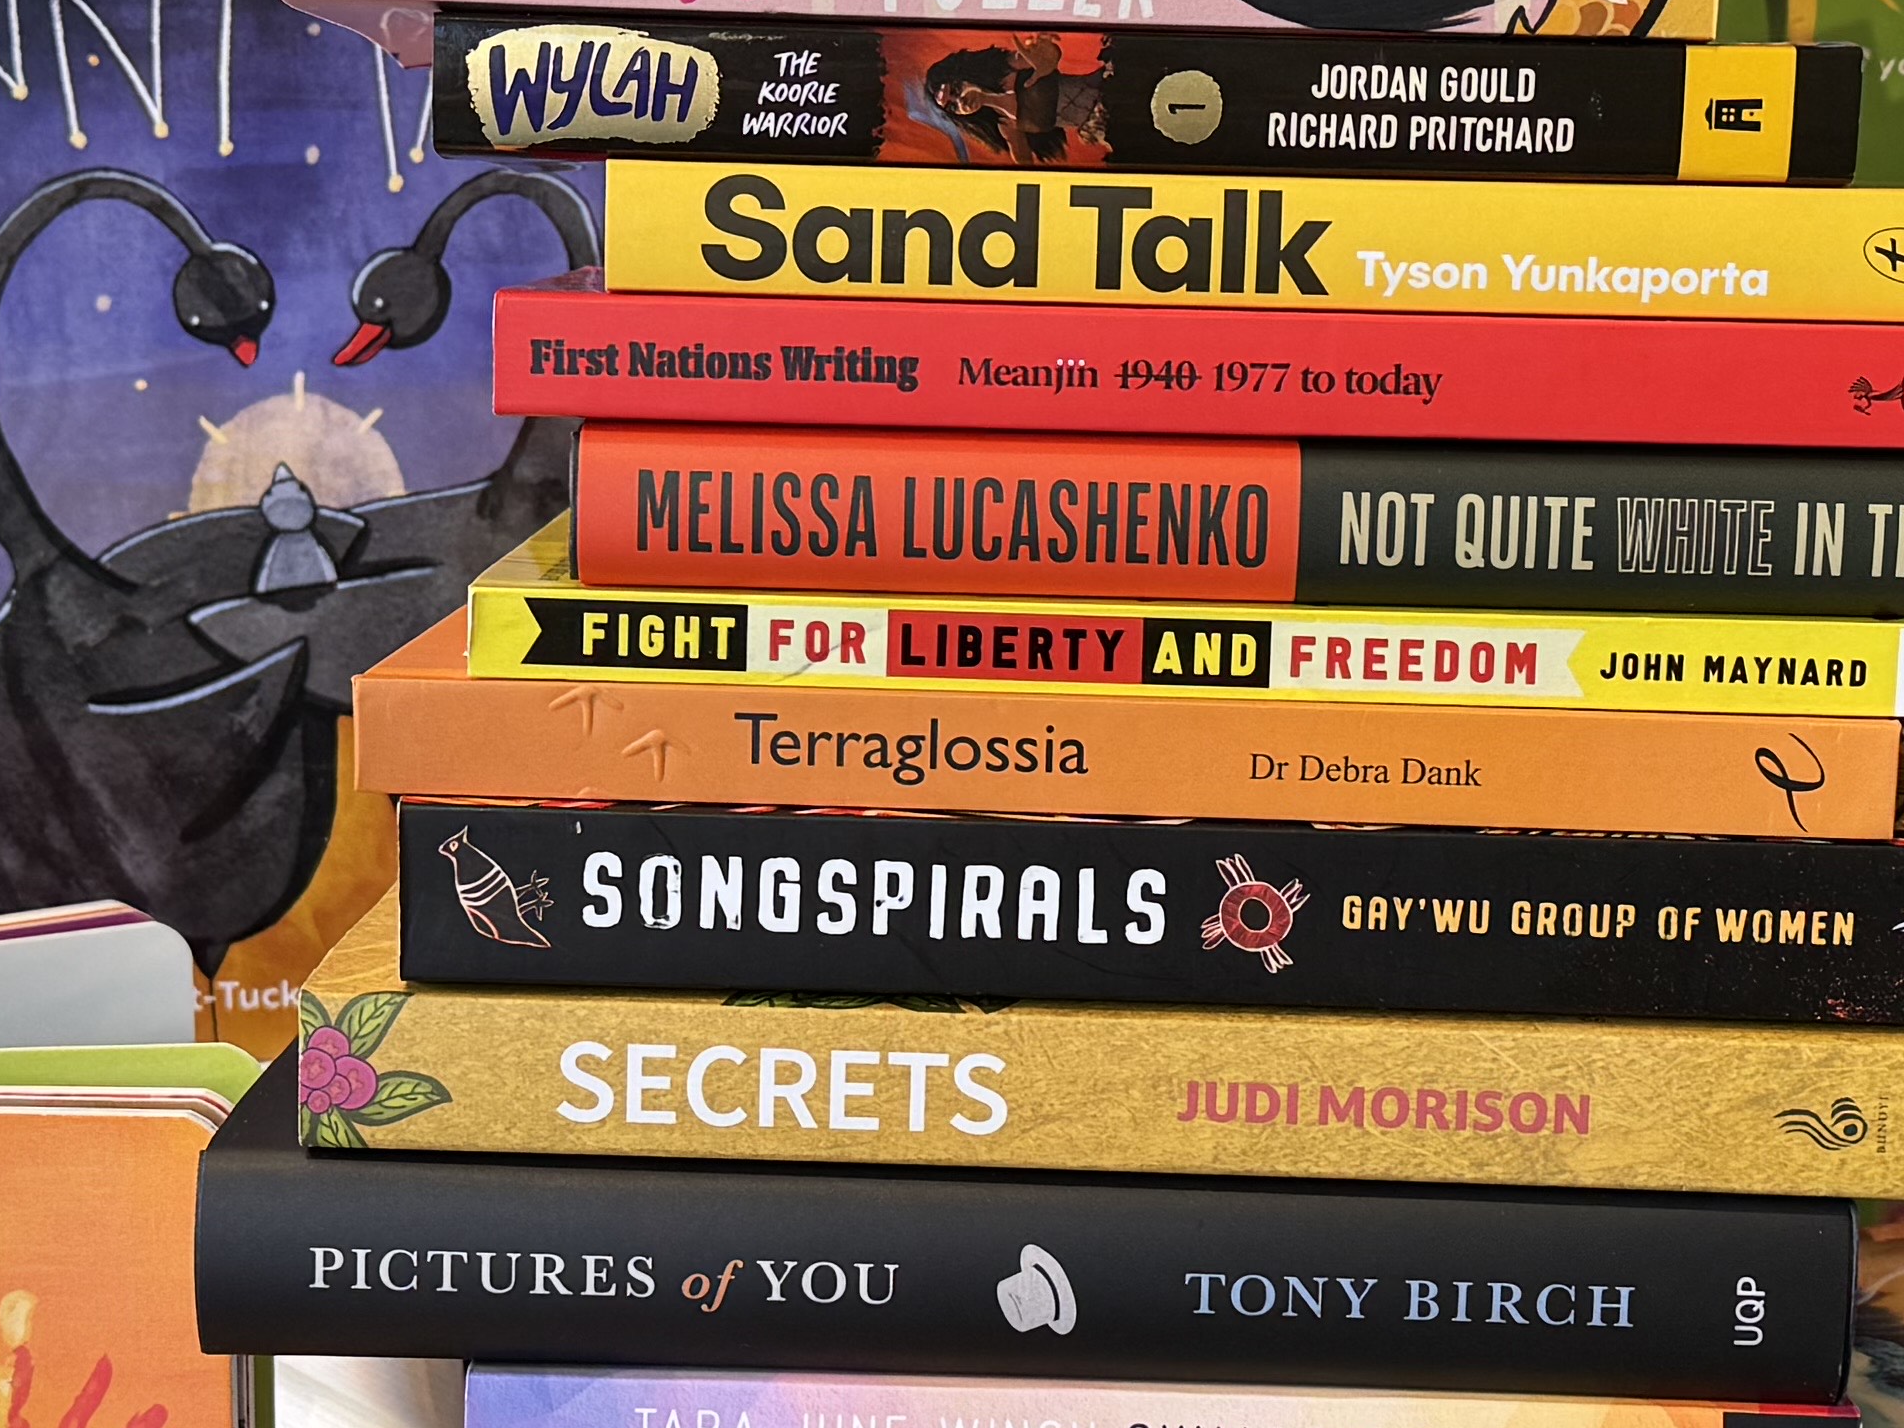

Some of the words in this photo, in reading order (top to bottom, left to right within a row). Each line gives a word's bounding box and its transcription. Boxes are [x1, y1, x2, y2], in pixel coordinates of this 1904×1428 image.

[484, 41, 698, 134] WYLAH
[756, 80, 838, 110] KOORIE
[772, 50, 821, 80] THE
[741, 110, 848, 141] WARRIOR
[701, 172, 1038, 290] Sand
[1068, 184, 1331, 296] Talk
[1356, 251, 1490, 300] Tyson
[1501, 254, 1768, 304] Yunkaporta
[530, 337, 621, 380] First
[627, 342, 772, 382] Nations
[780, 344, 920, 390] Writing
[633, 466, 880, 559] MELISSA
[899, 475, 1269, 570] LUCASHENKO
[1339, 491, 1438, 570] NOT
[1451, 494, 1595, 572] QUITE
[1617, 498, 1775, 578] WHITE
[1793, 500, 1848, 581] IN
[736, 711, 1088, 784] Terraglossia
[1249, 749, 1291, 786] Dr
[1298, 751, 1389, 789] Debra
[1397, 754, 1482, 792] Dank
[556, 1040, 1009, 1137] SECRETS
[1176, 1079, 1299, 1127] JUDI
[1315, 1085, 1592, 1137] MORISON
